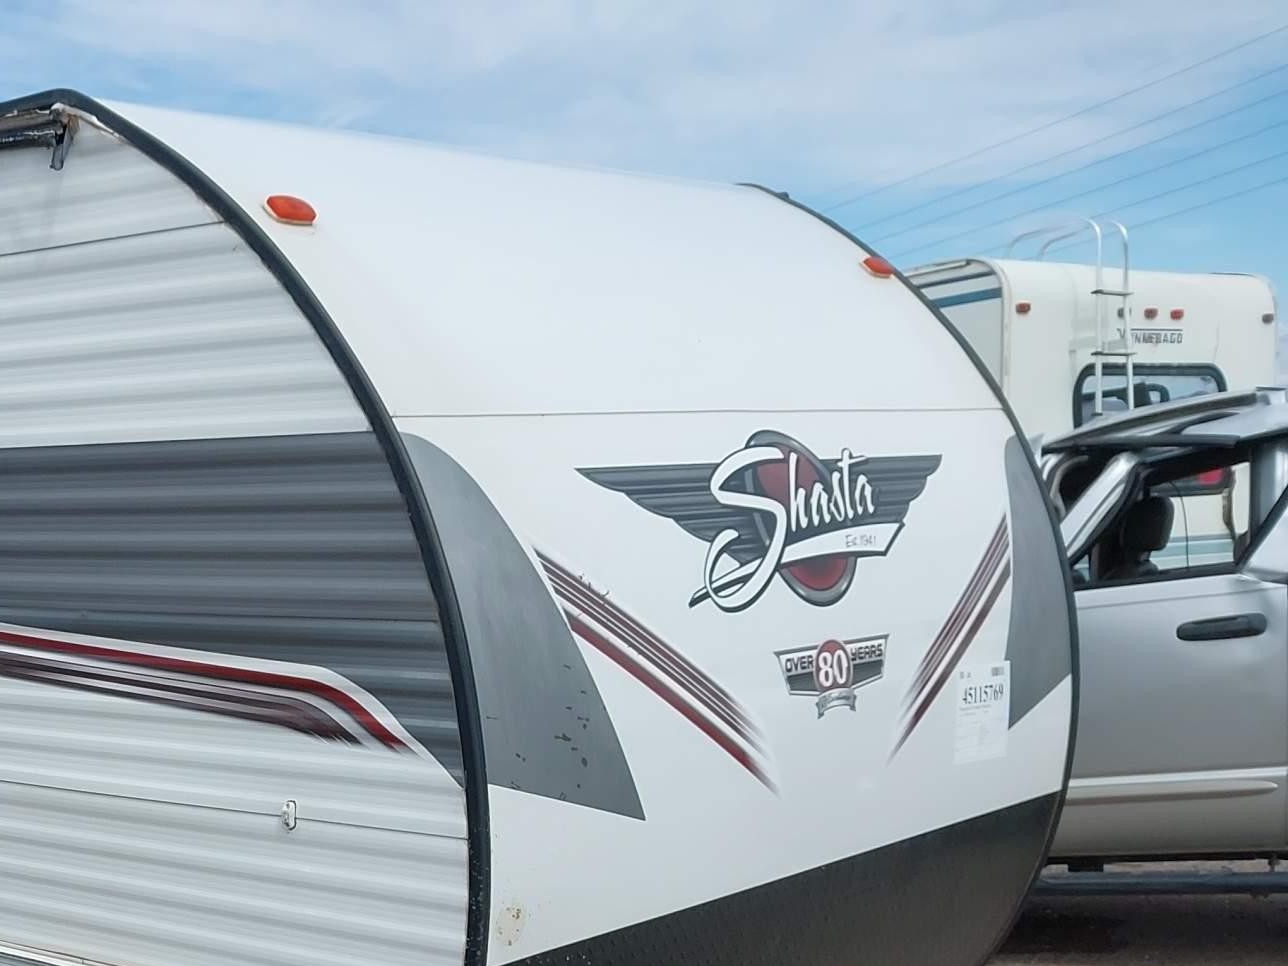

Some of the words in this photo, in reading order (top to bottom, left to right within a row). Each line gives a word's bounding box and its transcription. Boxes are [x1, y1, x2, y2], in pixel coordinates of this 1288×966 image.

[704, 446, 876, 612] Shasta
[784, 655, 814, 673] OVER
[817, 648, 850, 687] 80
[850, 643, 884, 662] YEARS
[962, 683, 1005, 705] 45115769
